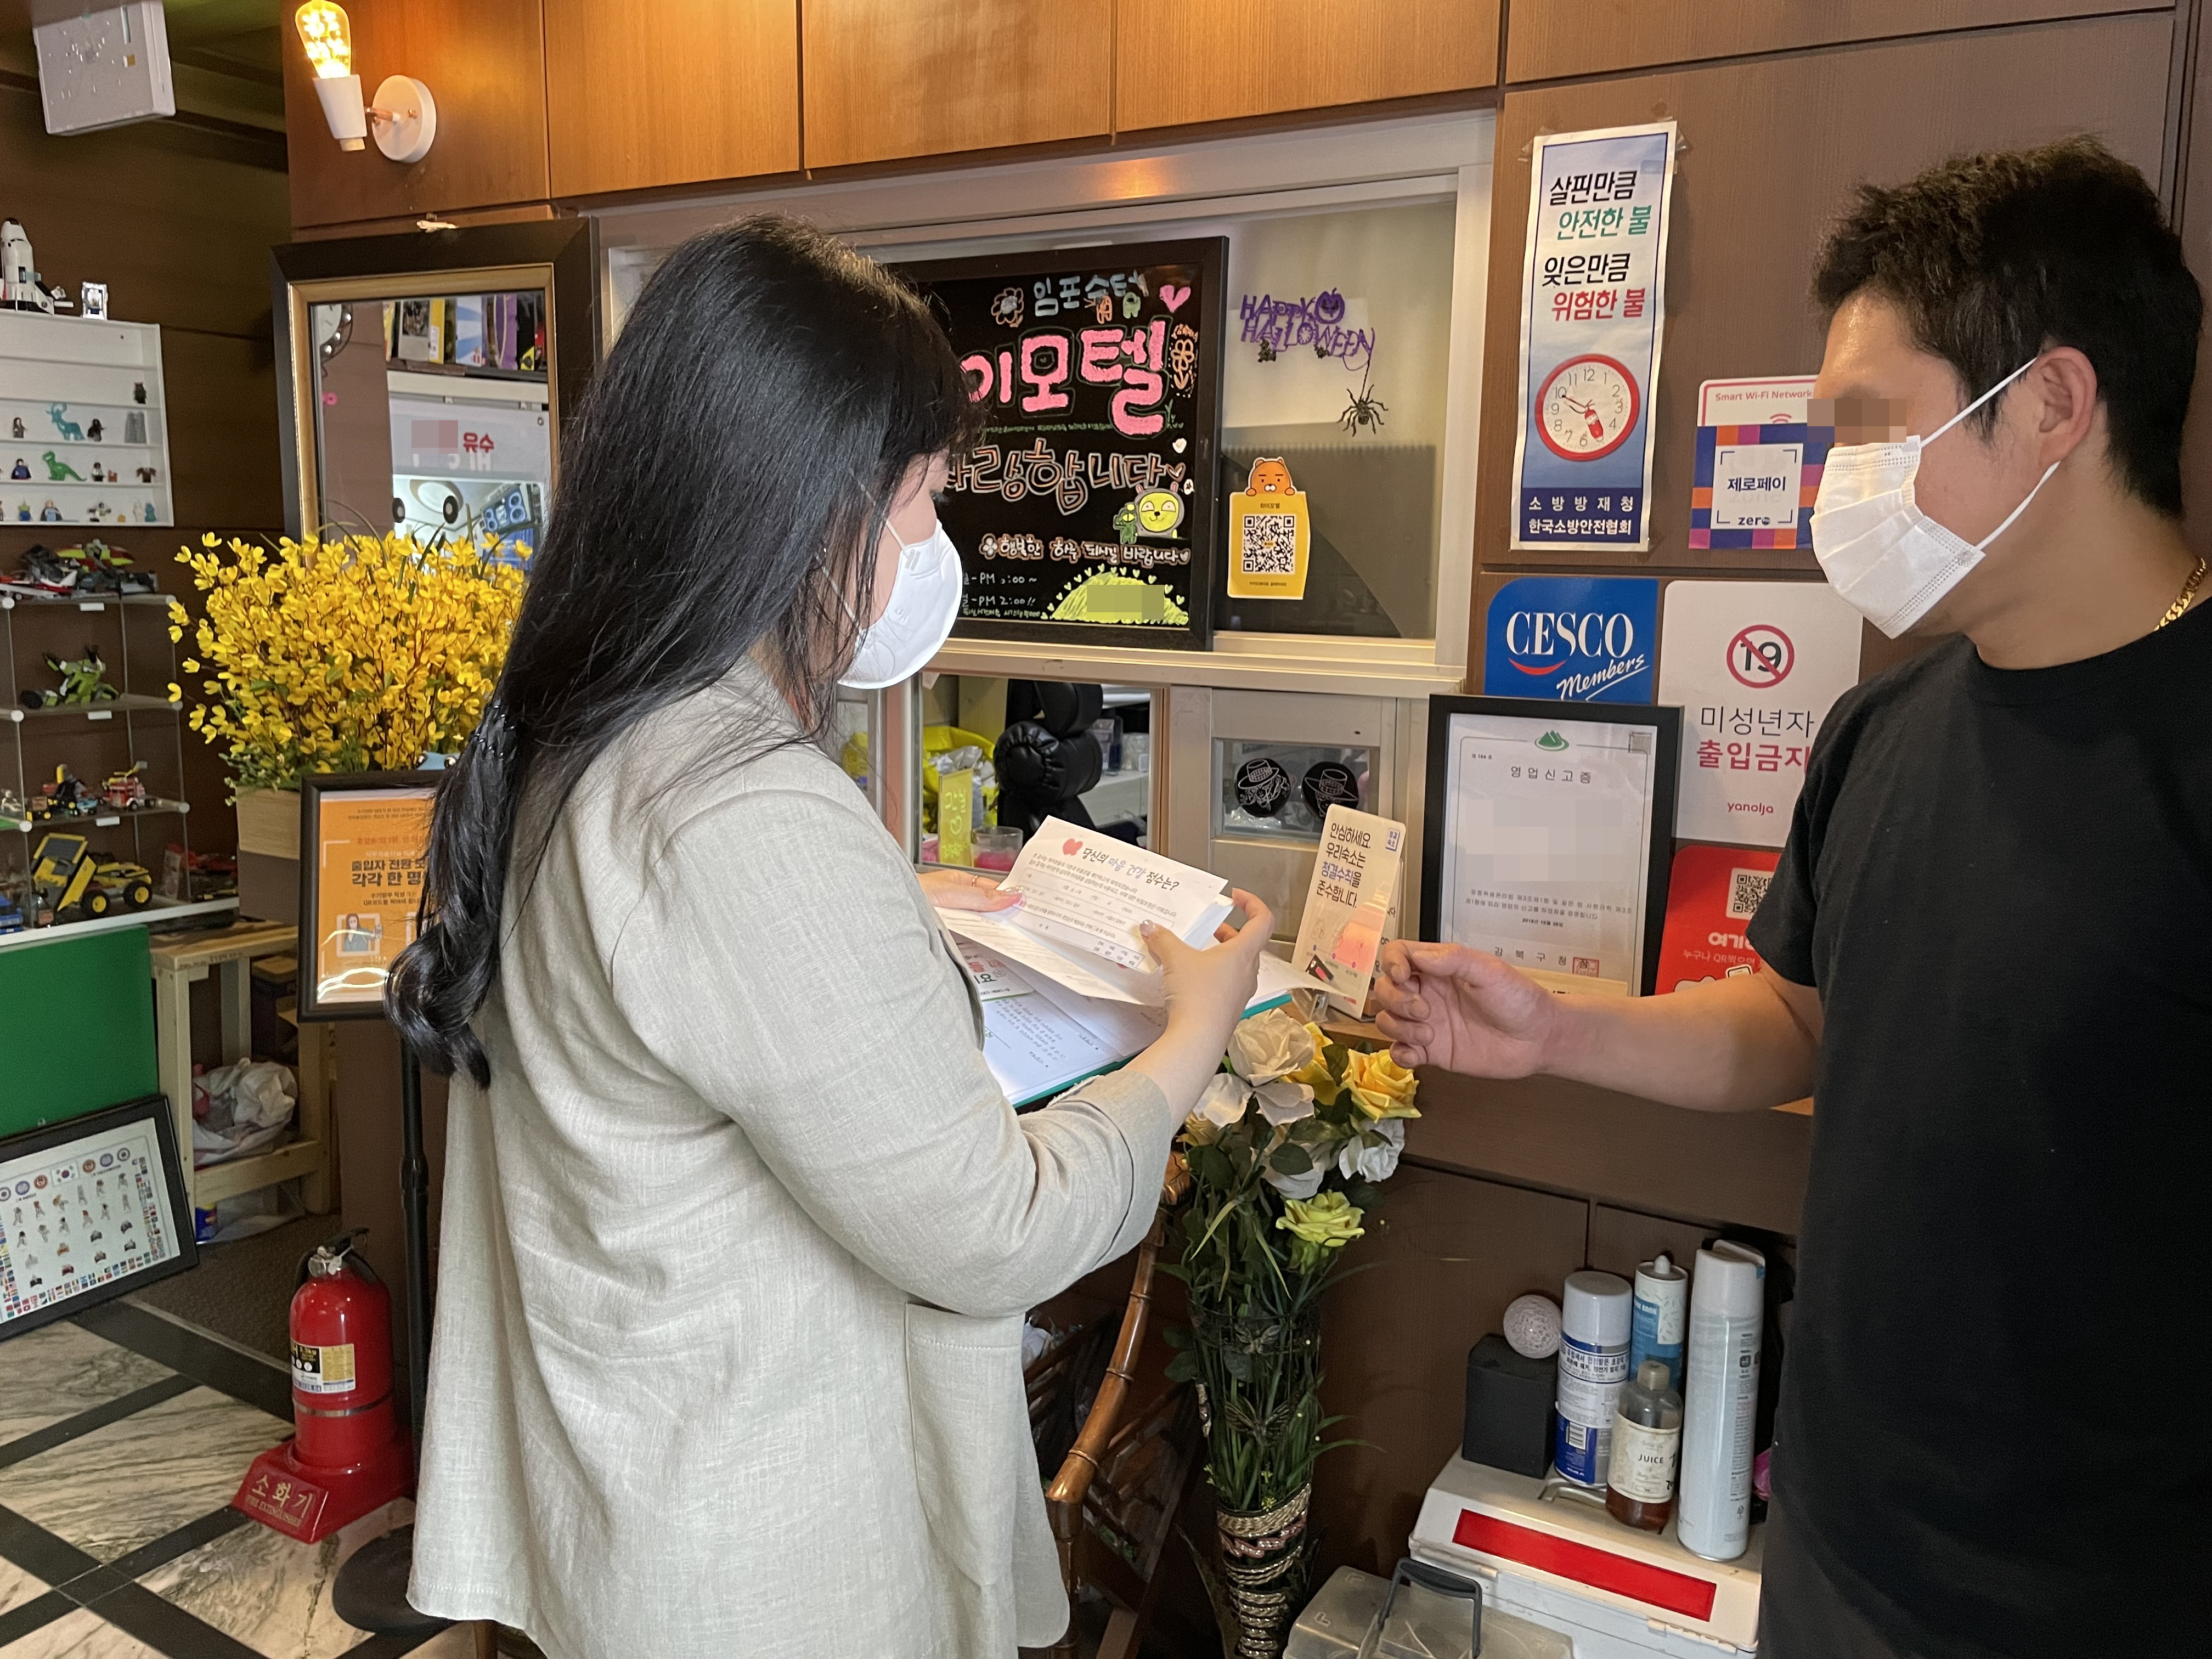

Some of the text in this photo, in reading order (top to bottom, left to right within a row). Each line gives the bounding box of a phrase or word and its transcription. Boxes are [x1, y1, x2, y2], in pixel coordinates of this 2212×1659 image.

[1550, 170, 1638, 206] 살핀만큼
[1557, 205, 1652, 240] 안전한 불
[1542, 252, 1631, 287] 잊은만큼
[1240, 294, 1316, 325] HAPPY
[1551, 287, 1645, 321] 위험한 불
[1240, 318, 1375, 358] HALLOWEEN
[1584, 369, 1595, 381] 12
[1555, 386, 1567, 399] 10
[1612, 385, 1620, 397] 2
[1715, 392, 1743, 402] Smart
[1771, 389, 1813, 399] Network
[1551, 403, 1560, 415] 9
[1554, 419, 1563, 432] 8
[1609, 418, 1617, 430] 4
[1727, 476, 1786, 492] 제로페이
[1529, 519, 1632, 535] 한국소방안전협회
[1000, 538, 1178, 566] 행복한 하루 되시길 바랍니다
[1506, 611, 1634, 658] CESCO
[1740, 641, 1782, 673] 19
[1556, 653, 1645, 701] Members
[1701, 706, 1815, 738] 미성년자
[1696, 739, 1811, 774] 출입금지
[1728, 802, 1774, 816] yanolja
[1330, 823, 1371, 849] 안심하세요.
[352, 872, 383, 888] 각각
[1082, 847, 1180, 891] 당신의 마음 건강 점수는?
[1316, 879, 1357, 909] 준수합니다.
[1638, 1454, 1664, 1464] JUICE
[252, 1474, 313, 1519] 소화기
